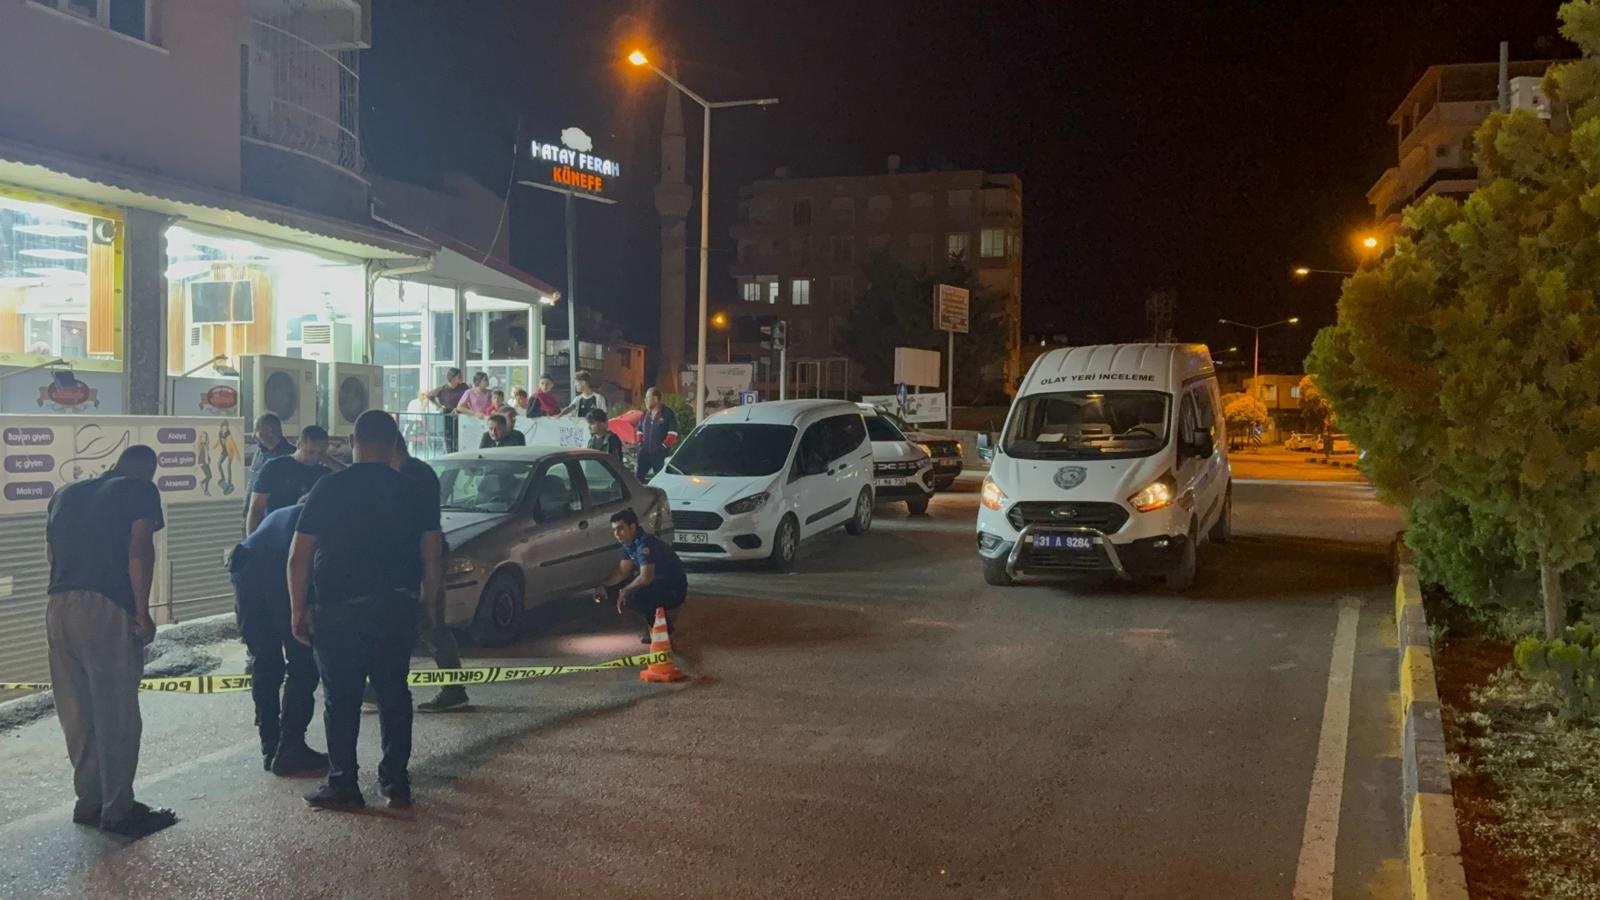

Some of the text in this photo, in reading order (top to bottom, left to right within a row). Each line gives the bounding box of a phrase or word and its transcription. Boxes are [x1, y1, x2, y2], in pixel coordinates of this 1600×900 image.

[531, 140, 620, 177] HATAY FERAH
[552, 165, 604, 192] KÜNEFE
[1040, 373, 1155, 386] OLAY YERİ İNCELEME
[1039, 536, 1050, 547] 31
[1055, 536, 1062, 547] A
